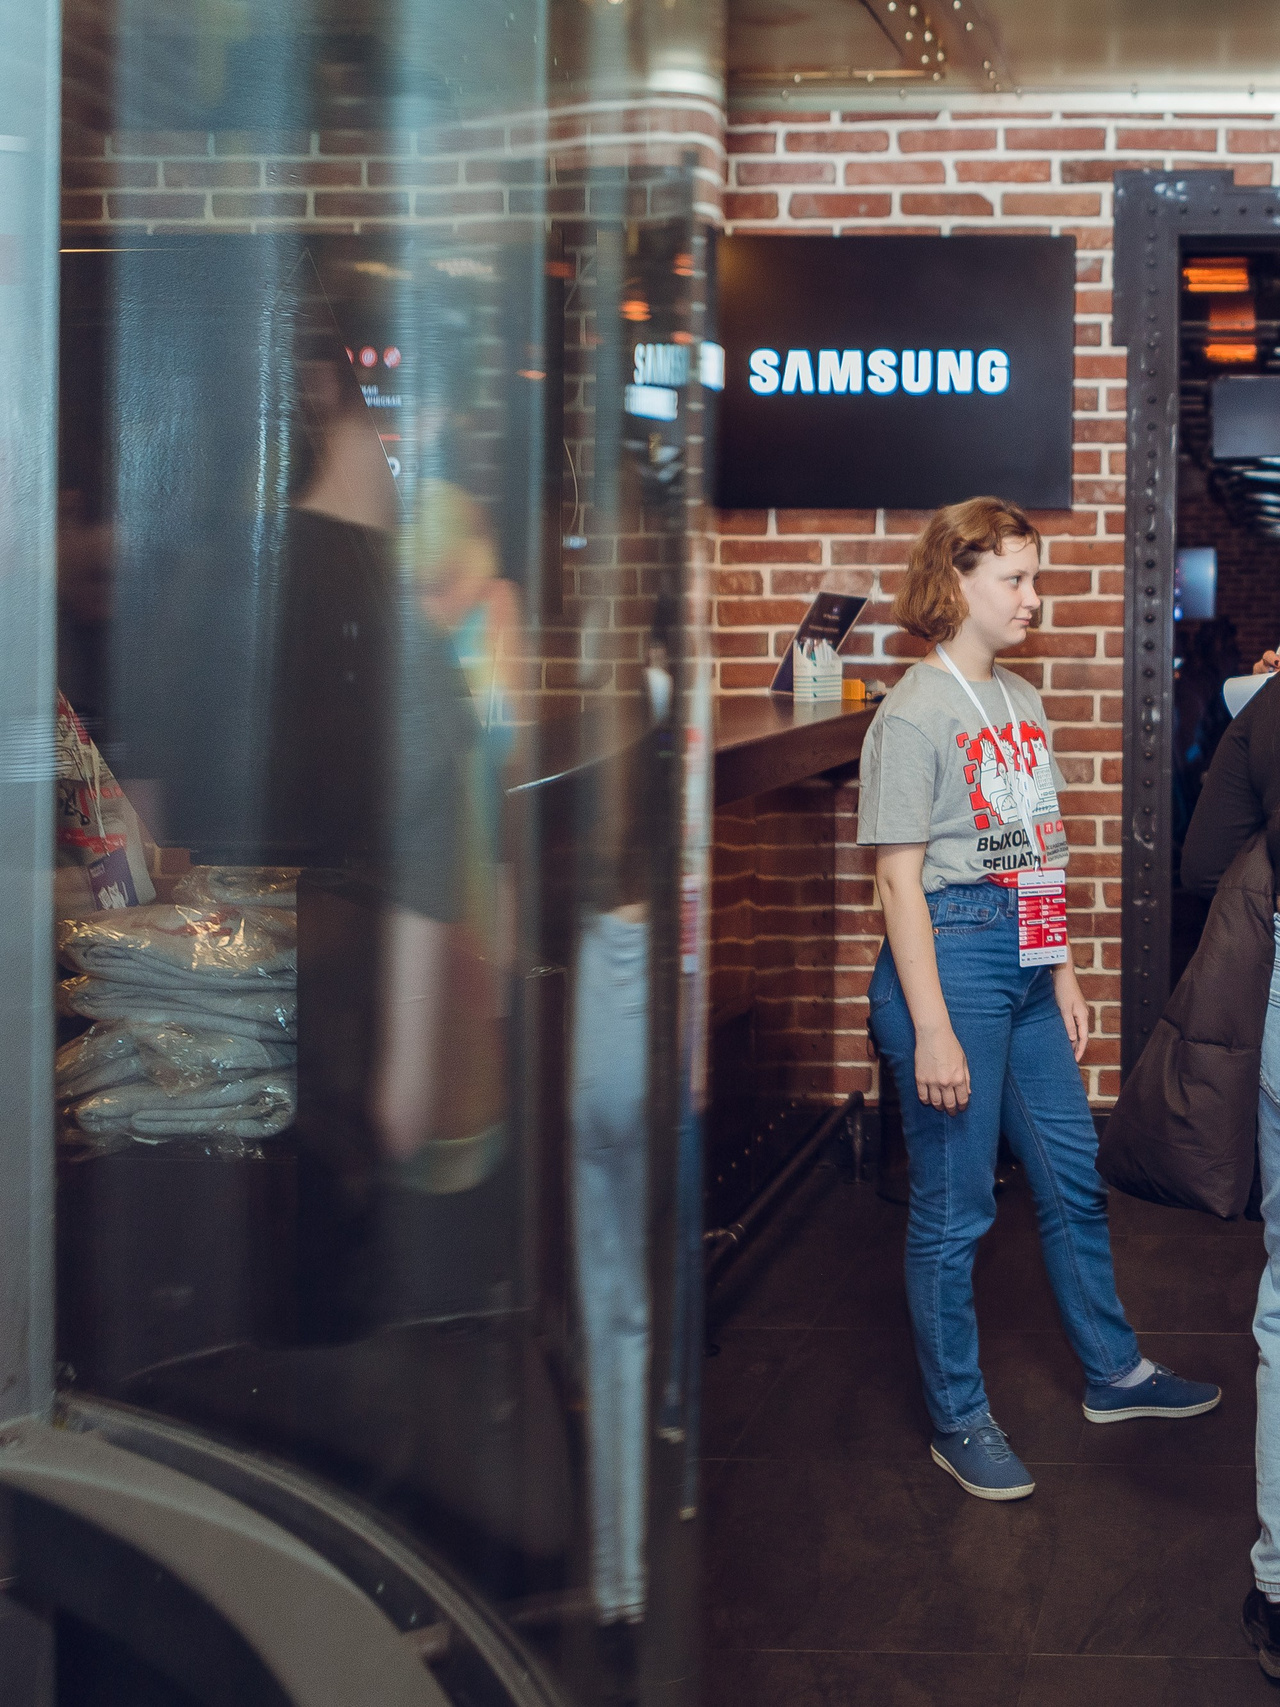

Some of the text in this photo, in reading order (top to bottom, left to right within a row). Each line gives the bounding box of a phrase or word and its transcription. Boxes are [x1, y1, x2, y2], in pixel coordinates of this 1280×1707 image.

[749, 348, 1010, 396] SAMSUNG
[976, 828, 1032, 852] ВЫХОД
[983, 850, 1037, 871] РЕШАТ
